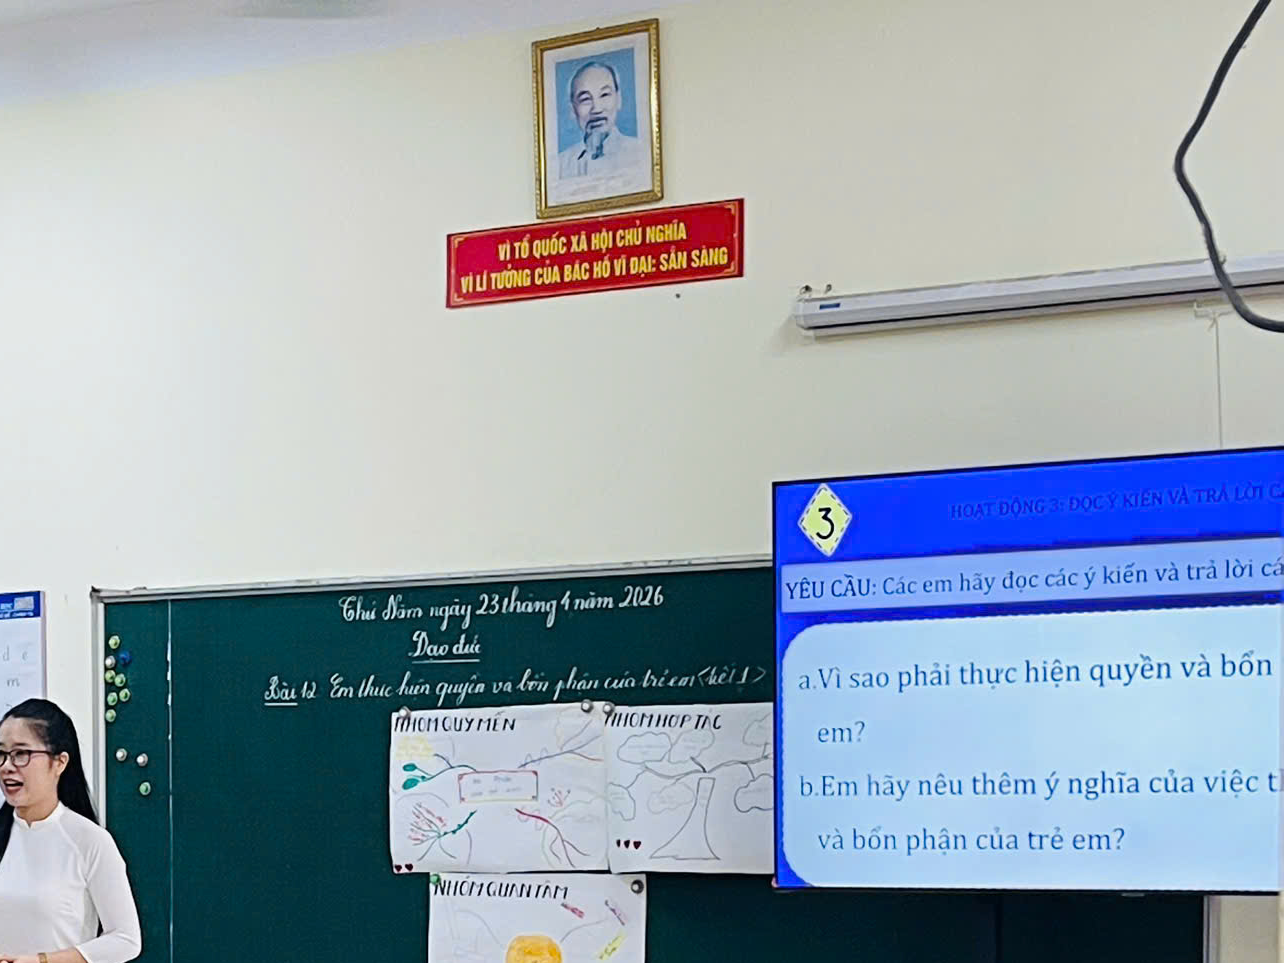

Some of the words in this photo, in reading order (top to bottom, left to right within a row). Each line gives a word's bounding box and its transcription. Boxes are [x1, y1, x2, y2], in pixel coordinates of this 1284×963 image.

[498, 240, 510, 261] VÌ
[514, 233, 529, 259] TỔ
[533, 227, 566, 259] QUỐC
[571, 229, 588, 252] XÃ
[592, 231, 612, 252] HỘI
[616, 219, 642, 248] CHỦ
[646, 219, 687, 244] NGHĨA
[461, 269, 473, 294] VÌ
[476, 269, 486, 292] LÍ
[490, 260, 531, 290] TƯỞNG
[534, 260, 560, 285] CỦA
[564, 257, 590, 283] BÁC
[593, 251, 611, 278] HỒ
[614, 252, 627, 277] VĨ
[630, 250, 656, 275] ĐẠI:
[659, 245, 687, 271] SẴN
[691, 243, 728, 268] SÀNG
[951, 502, 996, 521] HOẠT
[999, 496, 1045, 519] ĐỘNG
[1069, 496, 1103, 516] ĐỌC
[1123, 490, 1163, 511] KIẾN
[1168, 484, 1190, 505] VÀ
[1195, 483, 1229, 504] TRẢ
[1235, 480, 1264, 501] LỜI
[815, 507, 835, 539] 3
[786, 573, 824, 600] YÊU
[830, 571, 877, 598] CẦU:
[882, 573, 917, 596] Các
[923, 578, 953, 594] em
[959, 569, 996, 599] hãy
[1002, 569, 1039, 594] đọc
[1044, 567, 1078, 589] các
[1084, 566, 1097, 591] ý
[1103, 559, 1148, 586] kiến
[1156, 561, 1181, 583] và
[1187, 559, 1217, 580] trả
[1225, 557, 1254, 579] lời
[430, 598, 472, 631] ngày
[475, 593, 499, 615] 23
[574, 591, 614, 610] năm
[618, 585, 664, 608] 2026
[330, 673, 354, 698] Em
[849, 672, 889, 688] sao
[898, 661, 950, 692] phải
[959, 661, 1018, 690] thực
[1025, 656, 1081, 685] hiện
[1089, 653, 1171, 687] quyền
[1180, 654, 1211, 678] và
[1220, 650, 1272, 677] bổn
[817, 720, 866, 744] em?
[867, 773, 910, 802] hãy
[918, 773, 963, 796] nêu
[972, 772, 1036, 796] thêm
[1044, 769, 1061, 801] ý
[1067, 768, 1140, 801] nghĩa
[1148, 767, 1195, 793] của
[1203, 767, 1257, 795] việc
[817, 831, 845, 851] và
[852, 826, 897, 851] bổn
[906, 826, 967, 857] phận
[975, 826, 1019, 851] của
[1028, 826, 1064, 851] trẻ
[1072, 827, 1125, 851] em?
[487, 881, 532, 898] QUAN
[535, 880, 568, 900] TÂM
